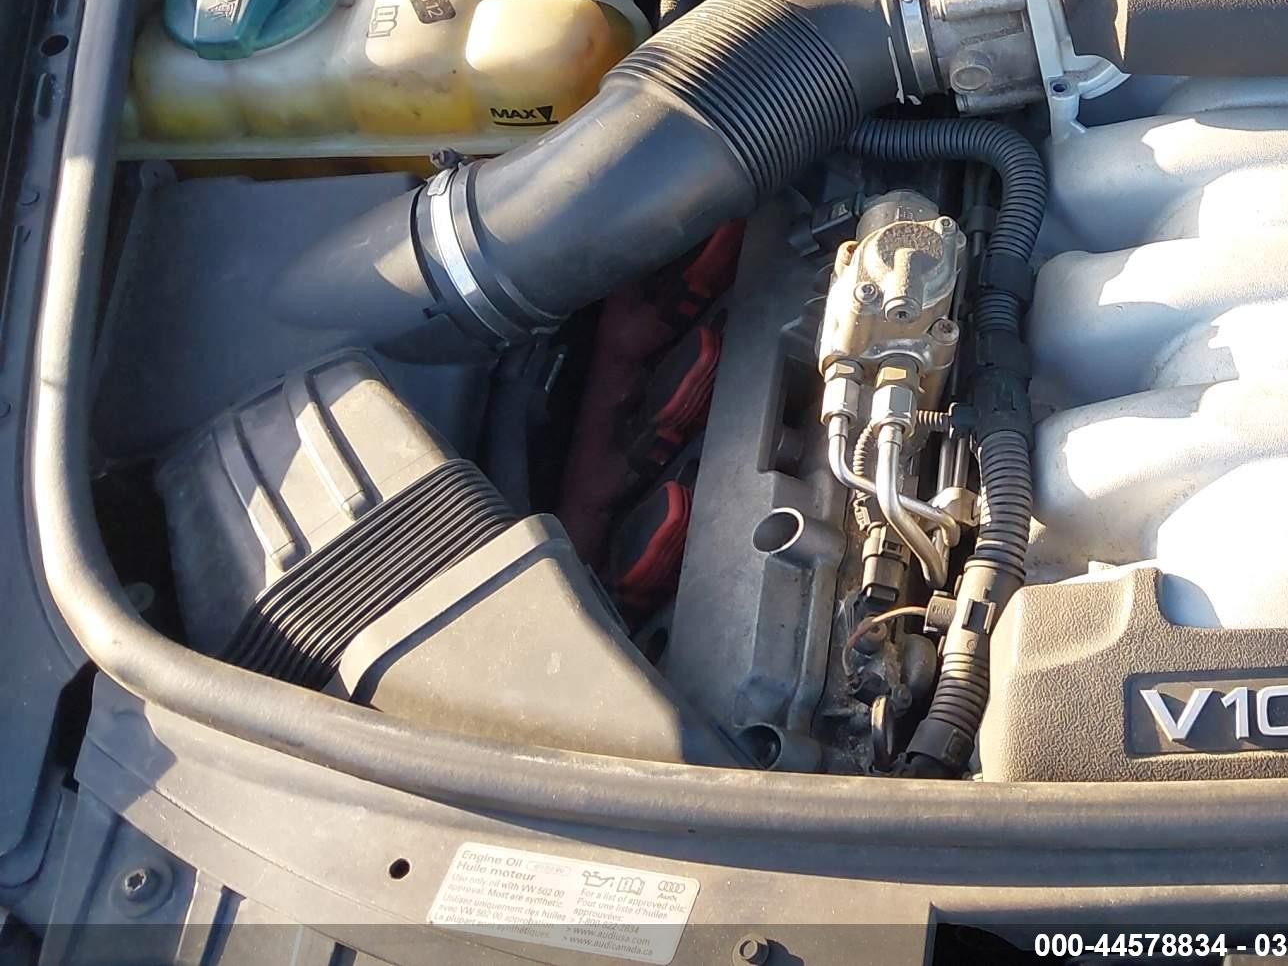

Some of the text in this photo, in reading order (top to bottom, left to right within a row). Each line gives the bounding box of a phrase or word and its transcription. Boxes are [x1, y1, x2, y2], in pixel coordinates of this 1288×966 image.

[490, 107, 537, 119] MAX
[461, 850, 523, 867] Engine Oil
[457, 861, 487, 874] Huile
[490, 868, 536, 881] moteur
[488, 889, 509, 900] Most
[510, 893, 524, 901] are
[502, 881, 519, 891] with
[521, 884, 537, 893] VW
[537, 887, 552, 897] 502
[554, 889, 565, 898] 00
[581, 888, 595, 897] For
[603, 891, 616, 901] list
[617, 894, 626, 903] of
[628, 897, 668, 910] approved
[598, 902, 614, 911] une
[525, 905, 540, 916] des
[573, 927, 650, 946] www.audiusa.com
